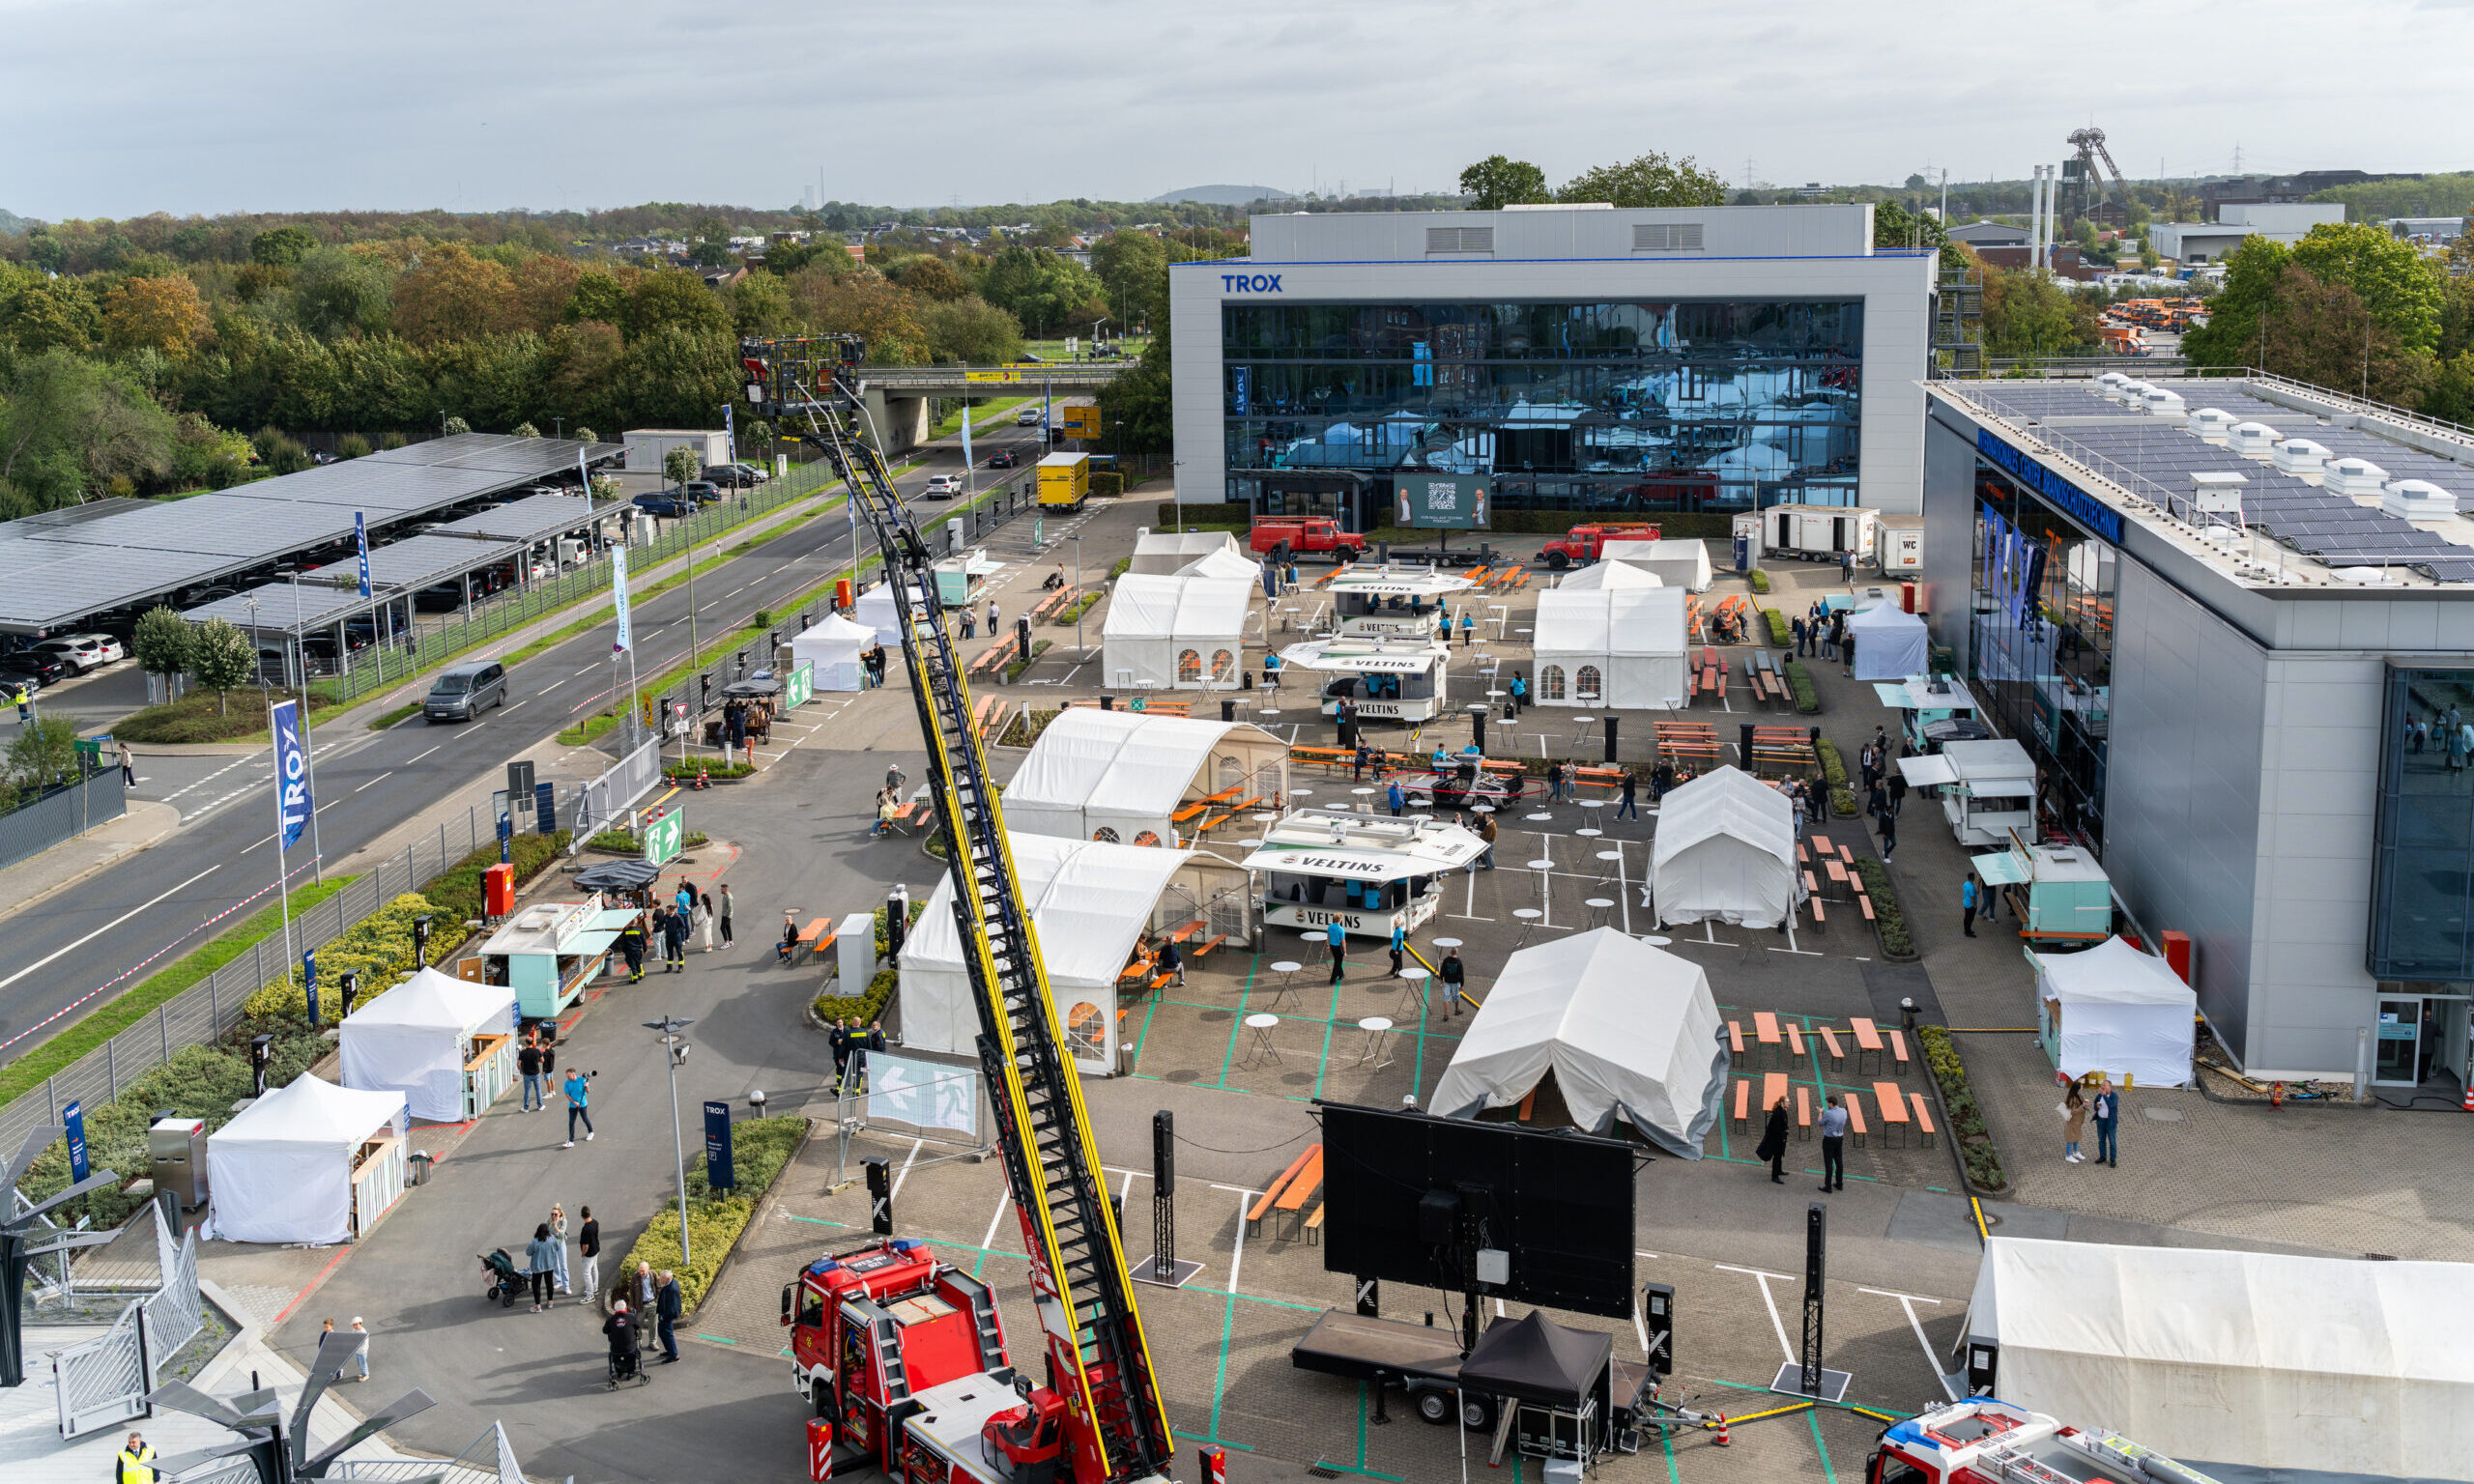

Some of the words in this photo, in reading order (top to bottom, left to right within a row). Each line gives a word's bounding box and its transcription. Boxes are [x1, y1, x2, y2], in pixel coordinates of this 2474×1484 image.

[1221, 274, 1283, 293] TROX
[2021, 455, 2041, 490] CENTER
[2043, 469, 2120, 544] BRANDSCHUTZTECHNIK
[1903, 540, 1916, 550] WC
[1359, 703, 1399, 715] VELTINS
[282, 723, 306, 835] TROX
[1302, 857, 1385, 872] VELTINS
[67, 1105, 81, 1119] TROX
[705, 1105, 727, 1115] TROX
[1026, 1235, 1044, 1283] FEUERWEHR
